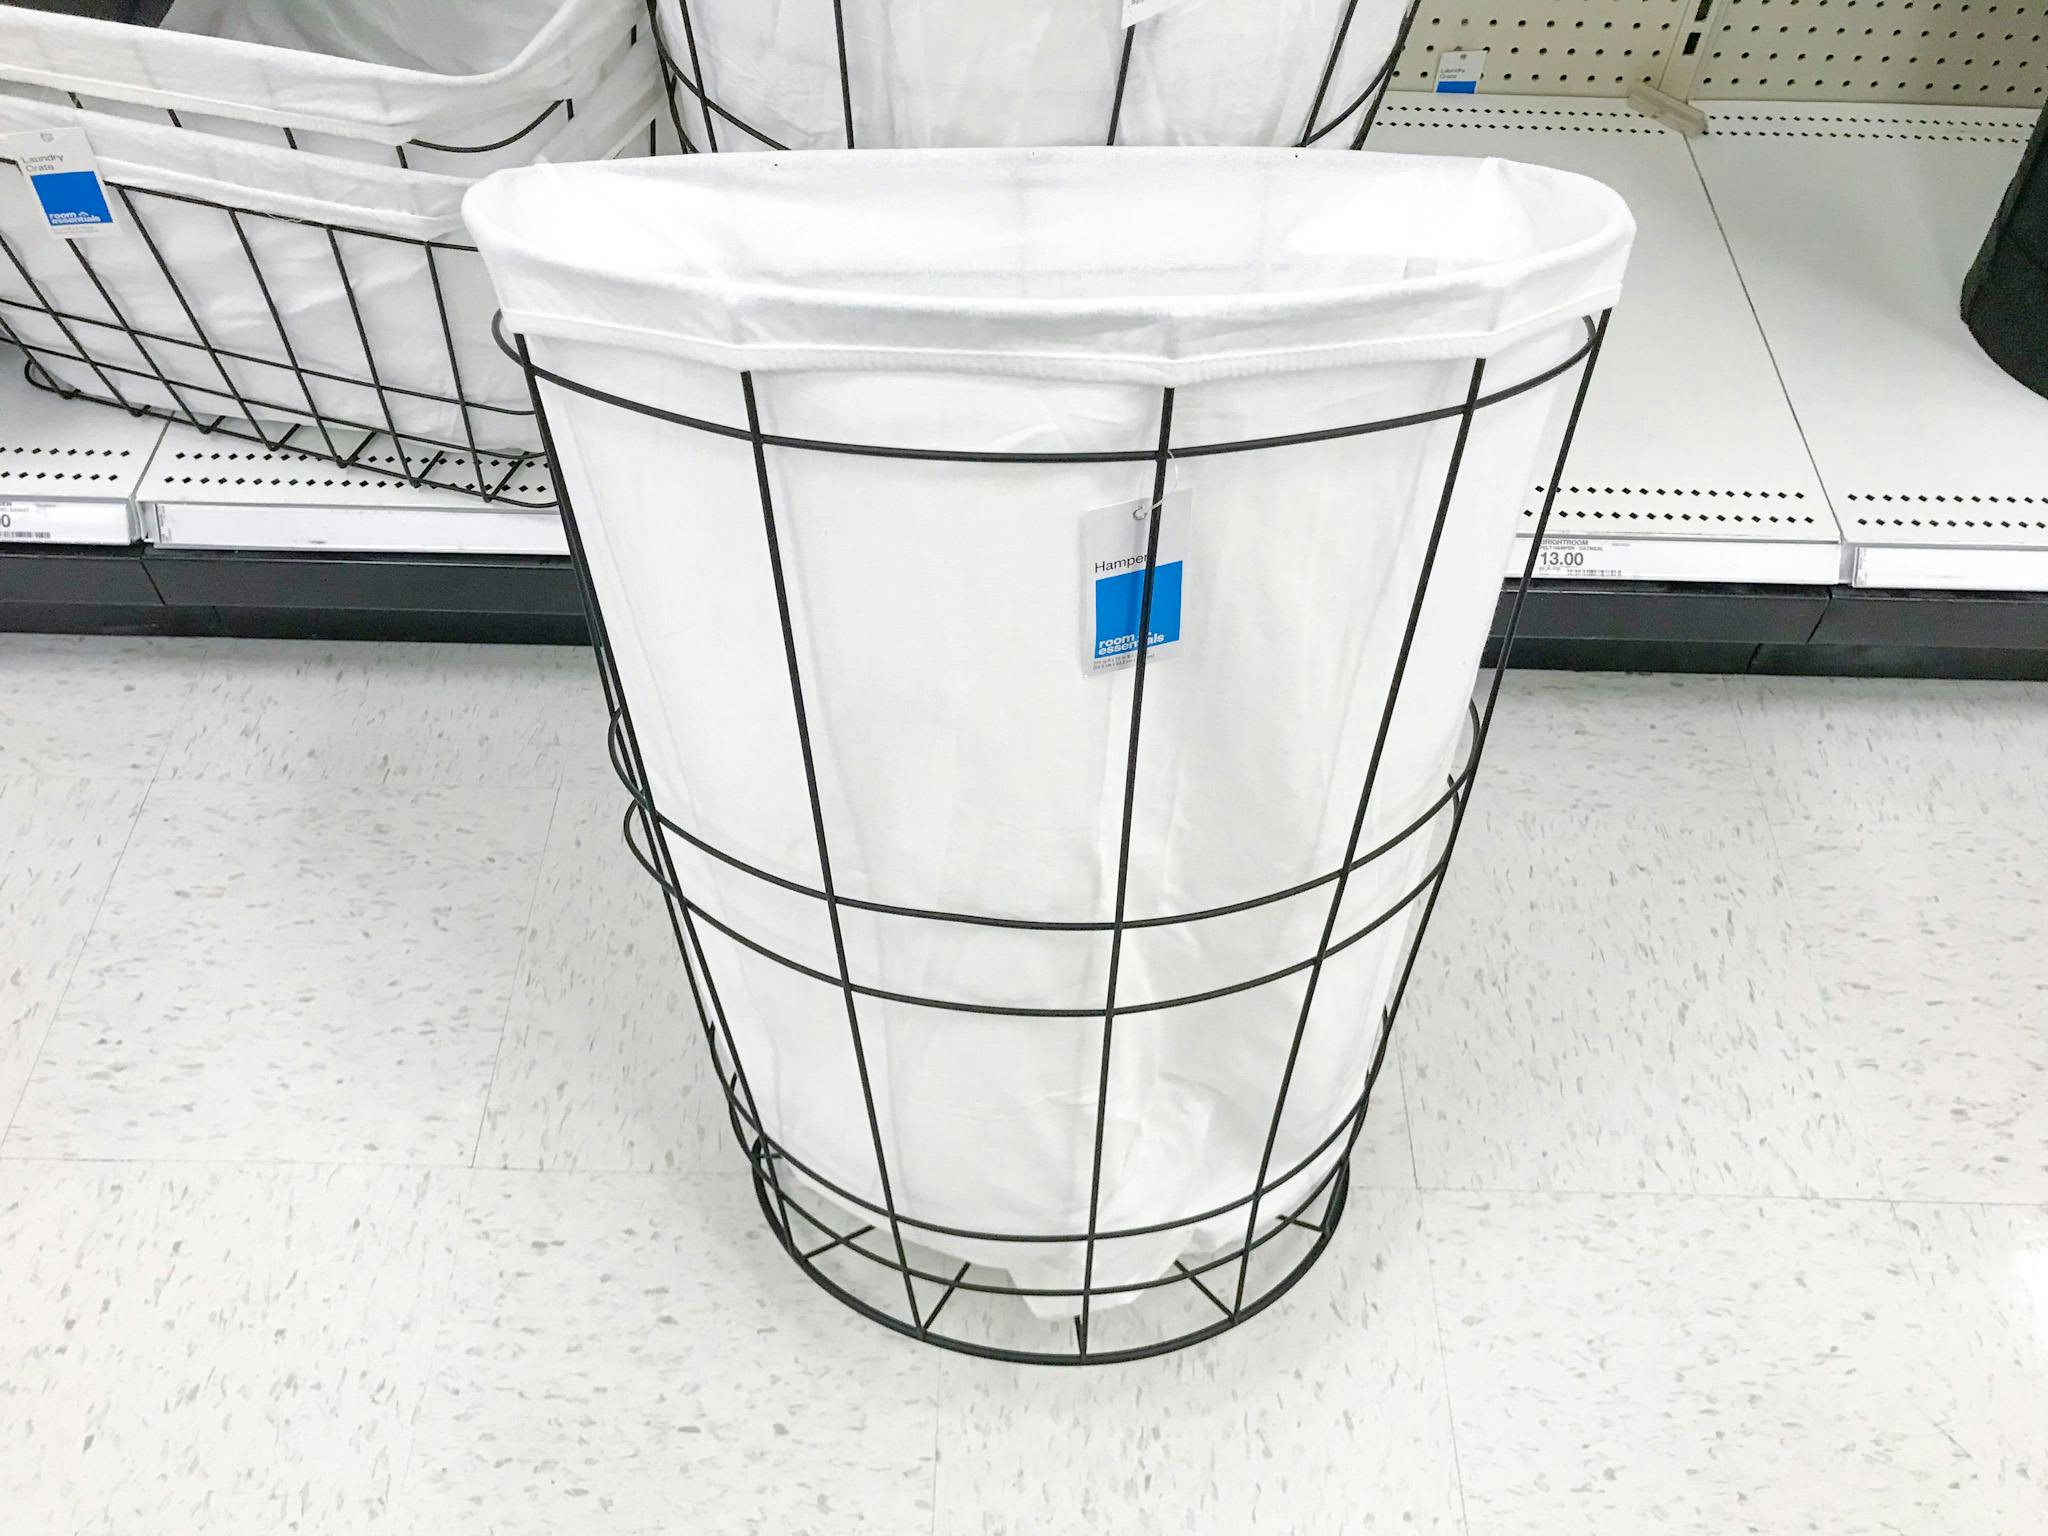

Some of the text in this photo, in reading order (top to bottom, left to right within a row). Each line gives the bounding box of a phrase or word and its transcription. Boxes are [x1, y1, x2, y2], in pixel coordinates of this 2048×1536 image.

[21, 153, 64, 164] Laundry
[49, 211, 77, 220] room
[1540, 552, 1584, 566] 13.00
[1098, 634, 1136, 649] room
